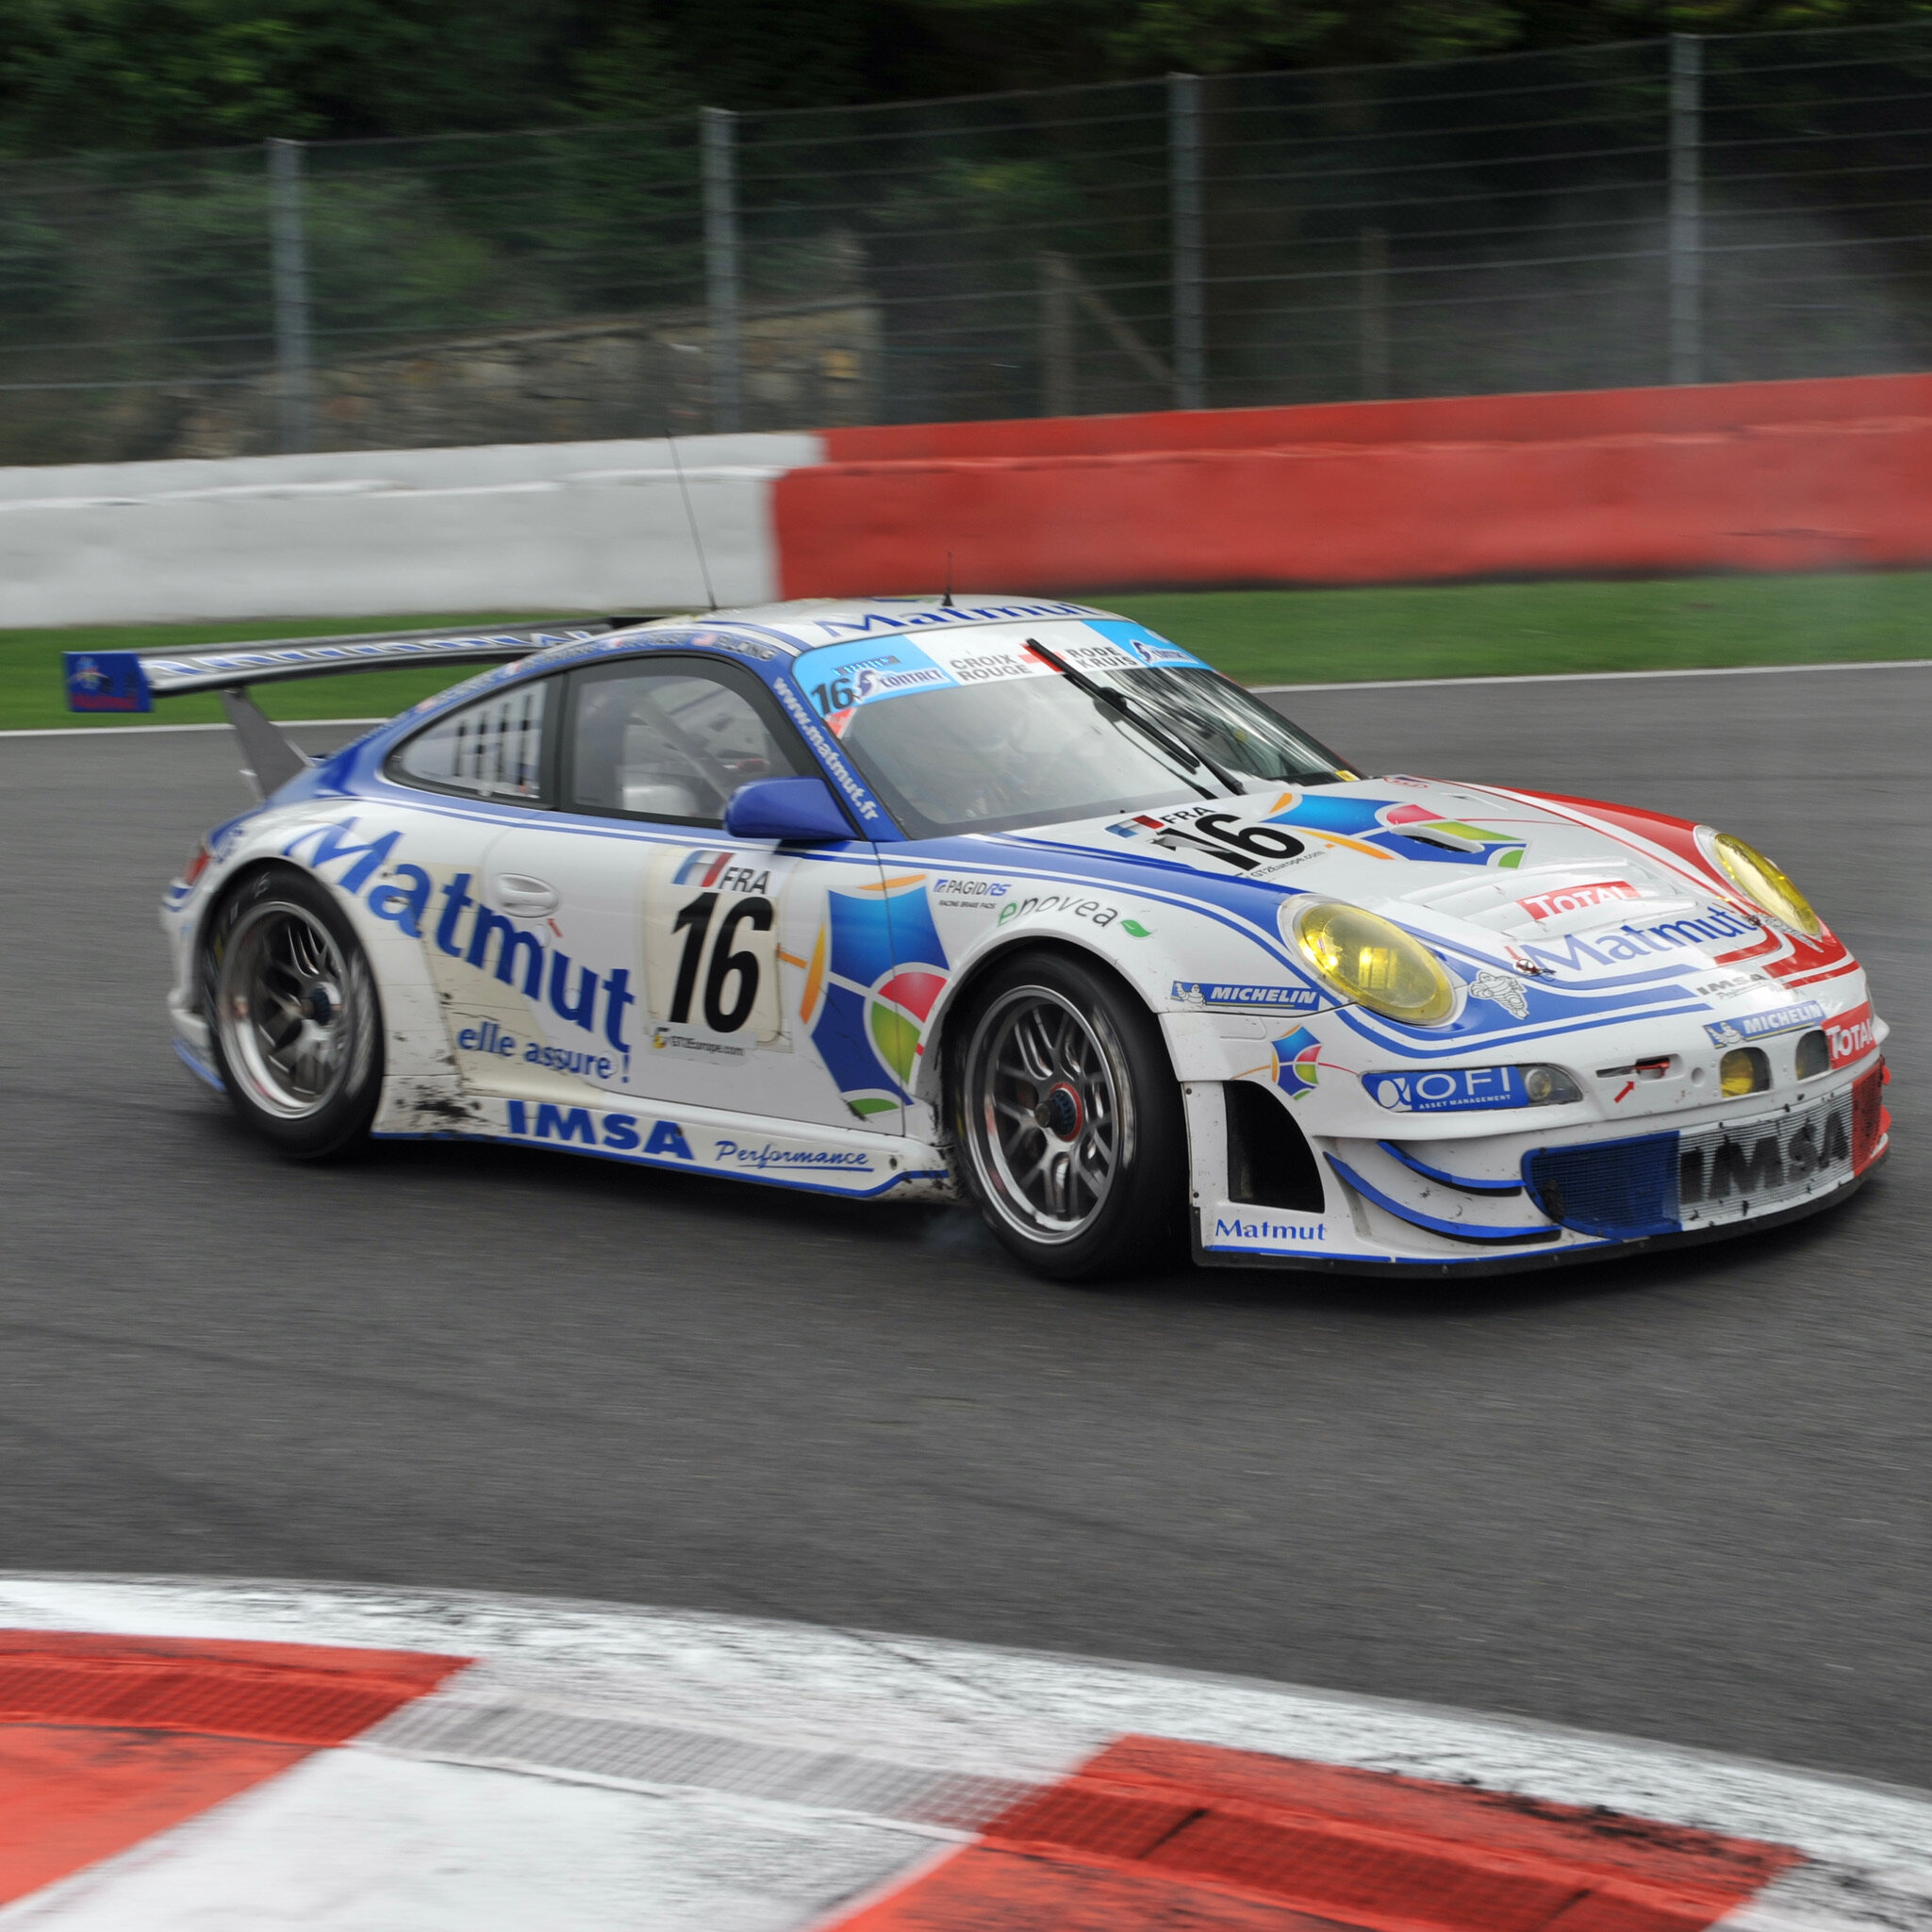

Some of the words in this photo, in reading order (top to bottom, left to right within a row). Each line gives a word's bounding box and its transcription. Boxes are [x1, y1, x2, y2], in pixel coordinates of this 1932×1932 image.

[815, 602, 1103, 637] Matmut
[949, 654, 1016, 671] CROIX
[1065, 646, 1120, 659] RODE
[1080, 656, 1138, 669] KRUIS
[956, 663, 1033, 683] ROUGE
[810, 678, 855, 715] 16
[772, 676, 879, 820] www.matmut.fr
[1159, 806, 1215, 825] FRA
[1156, 813, 1306, 871] 16
[718, 867, 771, 896] FRA
[997, 896, 1119, 928] enovea
[1525, 886, 1626, 916] TOTAL
[281, 815, 635, 1054] Matmut
[1519, 906, 1760, 971] Matmut
[669, 892, 773, 1033] 16
[1210, 986, 1316, 1004] MICHELIN
[1742, 1004, 1824, 1034] MICHELIN
[457, 1023, 515, 1057] elle
[524, 1042, 615, 1080] assure
[1415, 1066, 1511, 1100] OFI
[1419, 1100, 1447, 1110] ASSET
[1449, 1094, 1512, 1106] MANAGEMENT
[506, 1099, 695, 1161] IMSA
[714, 1139, 870, 1169] Performance
[1680, 1110, 1860, 1206] IMSA
[1215, 1218, 1326, 1241] Matmut
